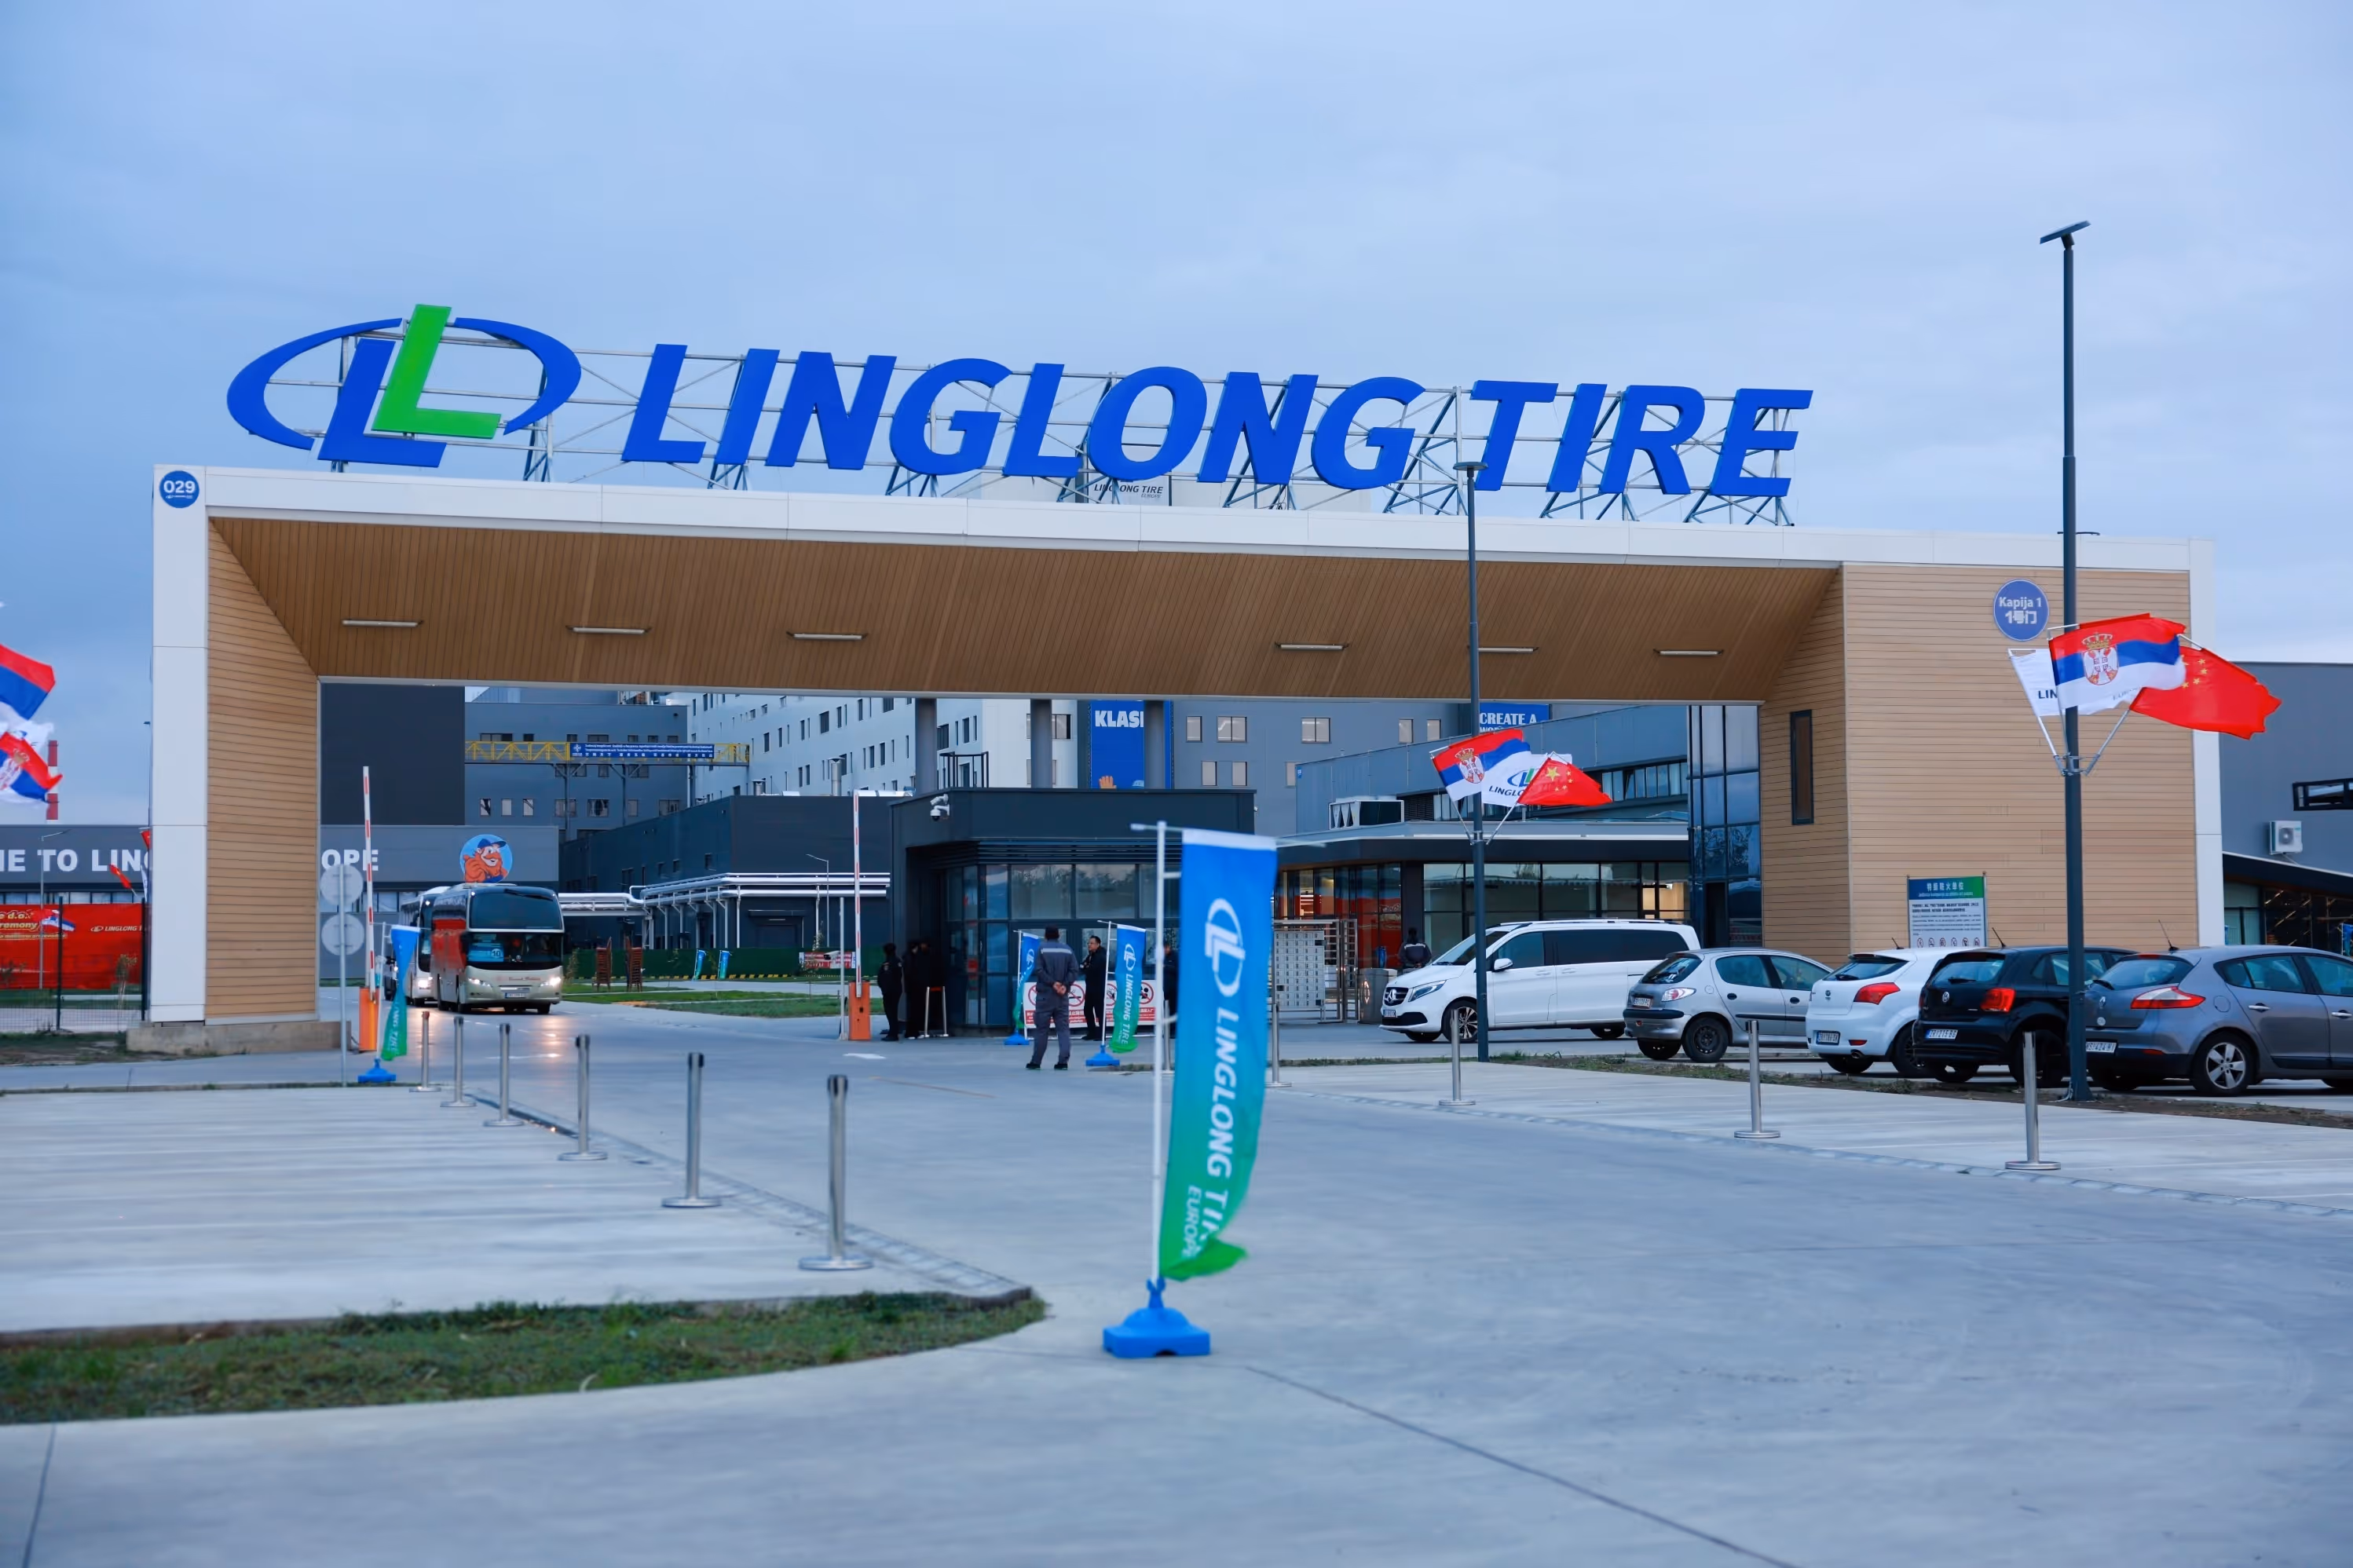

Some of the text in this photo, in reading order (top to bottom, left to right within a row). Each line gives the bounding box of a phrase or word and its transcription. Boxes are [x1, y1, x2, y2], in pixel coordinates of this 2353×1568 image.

[621, 343, 1813, 497] LINGLONG TIRE
[163, 480, 196, 493] 029
[1141, 485, 1163, 494] TIRE
[1999, 597, 2042, 609] Kapija 1
[1479, 712, 1537, 726] CREATE A
[37, 849, 78, 872] TO
[1123, 974, 1134, 1022] LINGLONG
[1207, 1007, 1239, 1179] LINGLONG
